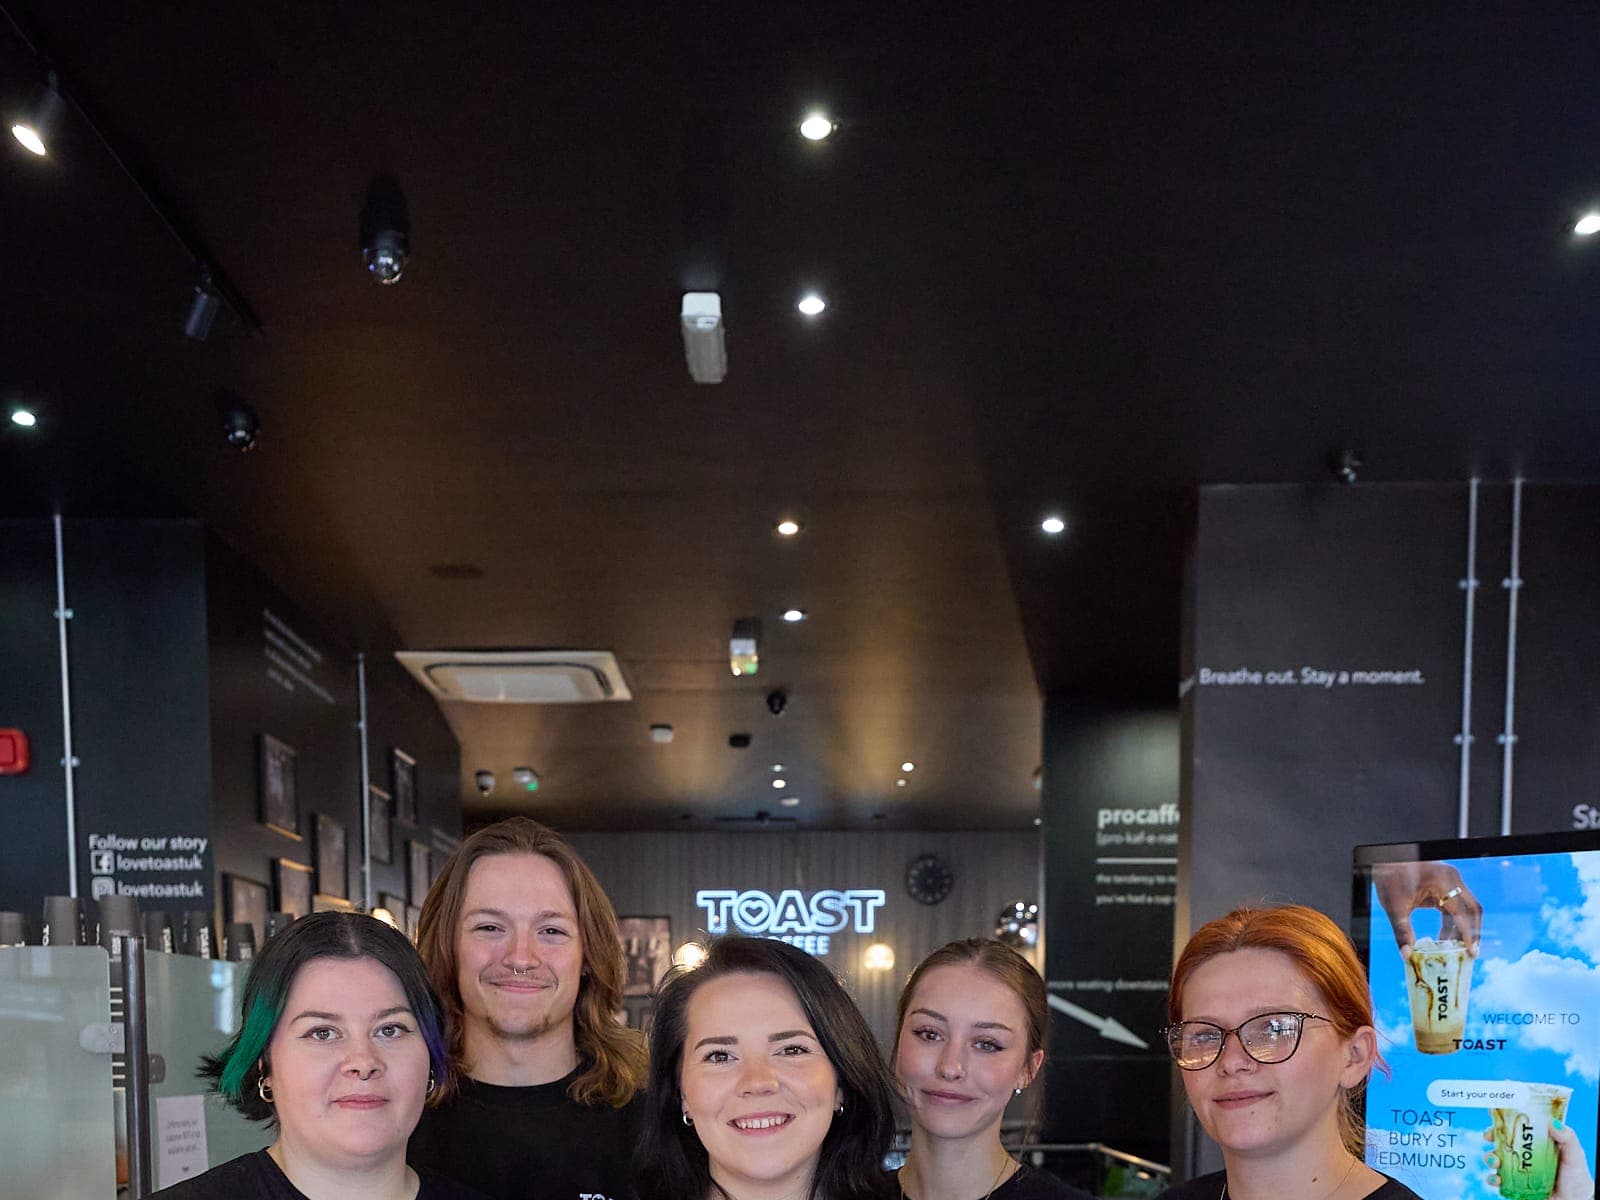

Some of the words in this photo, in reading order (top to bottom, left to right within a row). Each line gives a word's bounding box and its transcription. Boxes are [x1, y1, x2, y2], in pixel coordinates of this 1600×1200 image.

[1199, 667, 1263, 685] Breathe
[1264, 669, 1298, 685] out.
[1301, 667, 1336, 689] Stay
[1336, 671, 1350, 685] a
[1351, 669, 1425, 685] moment.
[1573, 803, 1600, 830] St
[88, 834, 138, 851] Follow
[140, 838, 168, 851] our
[169, 836, 208, 854] story
[116, 853, 203, 871] lovetoastuk
[117, 880, 204, 898] lovetoastuk
[696, 889, 886, 934] TOAST
[1438, 976, 1449, 1022] TOAST
[1483, 1012, 1556, 1026] WELCOME
[1560, 1012, 1581, 1026] TO
[1452, 1038, 1508, 1051] TOAST
[1440, 1089, 1464, 1098] Start
[1466, 1091, 1488, 1100] your
[1489, 1091, 1516, 1100] order
[1391, 1109, 1457, 1127] TOAST
[1389, 1132, 1433, 1147] BURY
[1437, 1133, 1458, 1148] ST
[1521, 1123, 1534, 1170] TOAST
[1379, 1151, 1467, 1169] EDMUNDS
